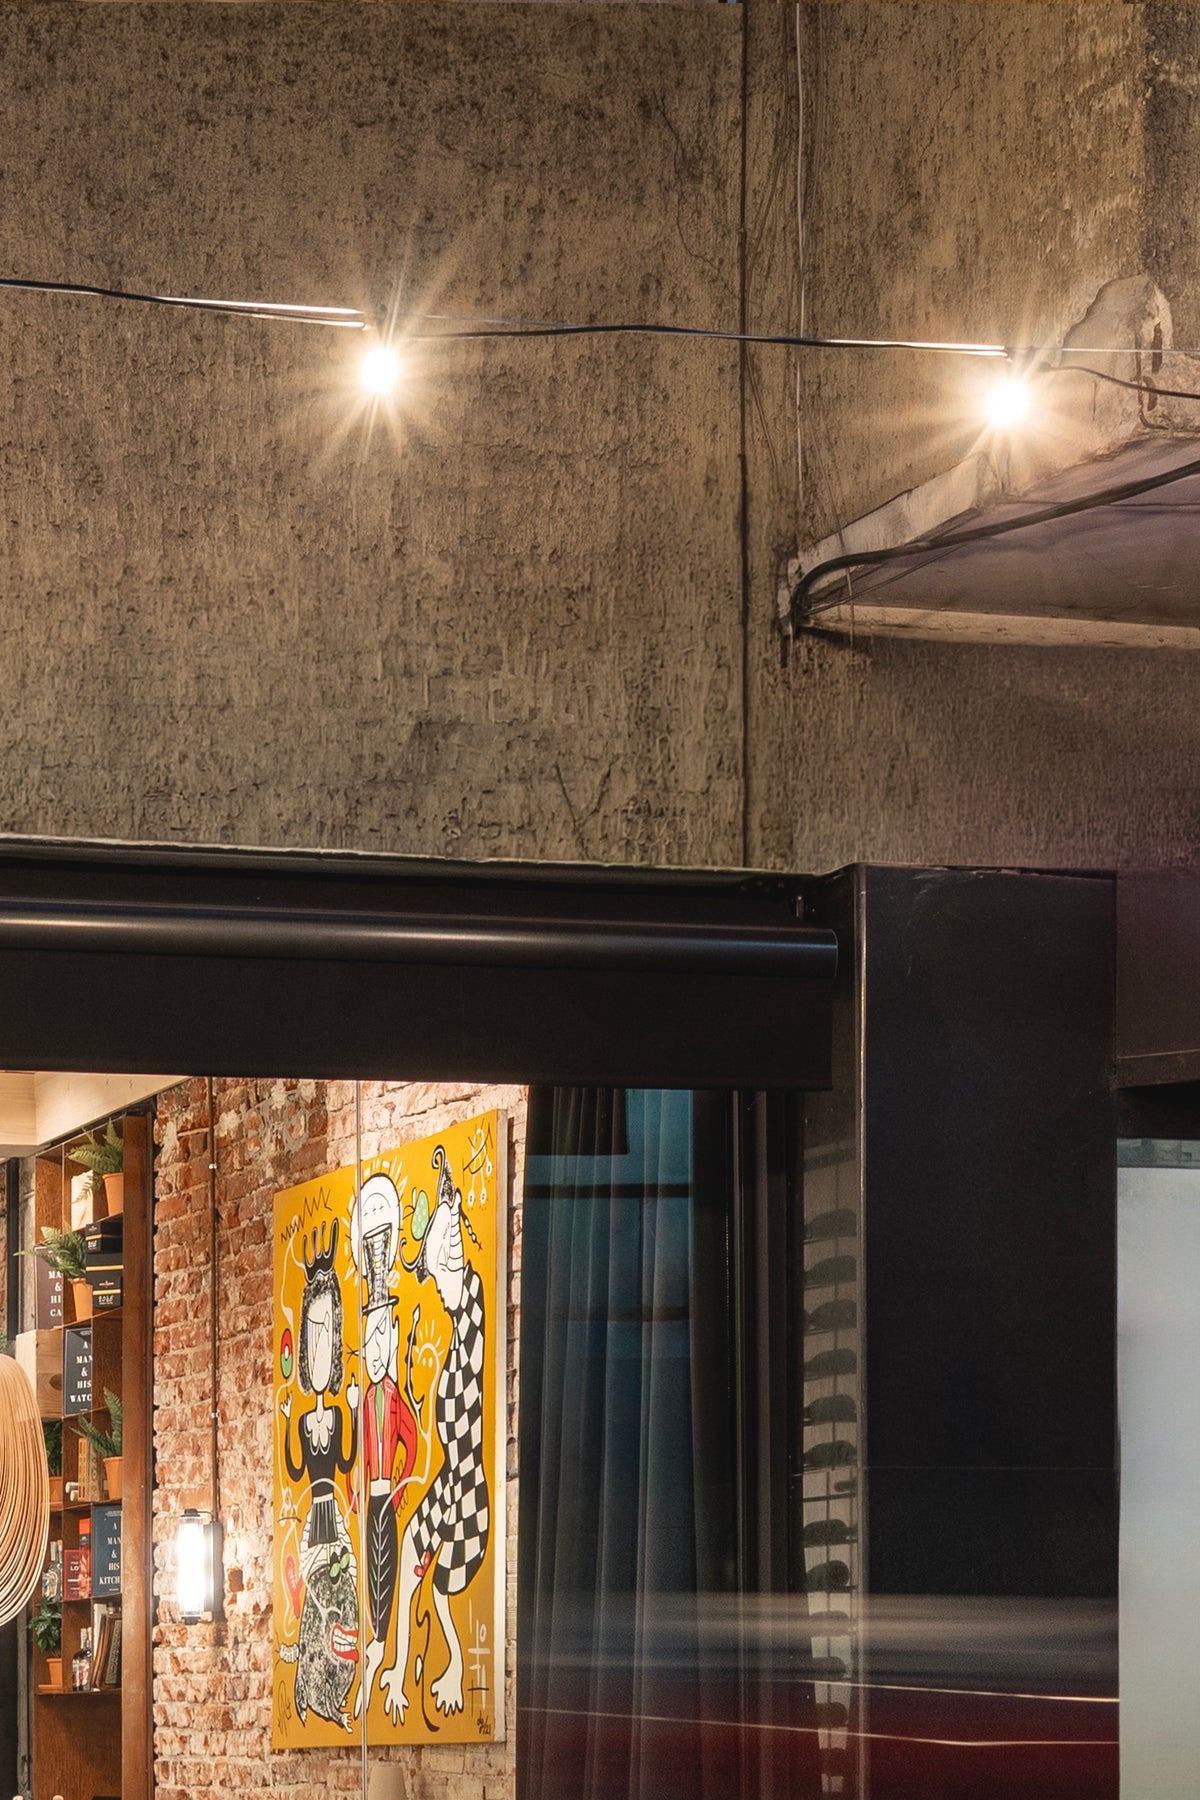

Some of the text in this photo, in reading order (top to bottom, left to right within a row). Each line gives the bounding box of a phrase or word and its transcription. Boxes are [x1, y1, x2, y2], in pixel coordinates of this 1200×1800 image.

[82, 1341, 89, 1349] A
[81, 1367, 88, 1377] &
[77, 1380, 92, 1389] HIS
[112, 1522, 118, 1530] A
[111, 1549, 118, 1559] &
[108, 1562, 120, 1571] HIS
